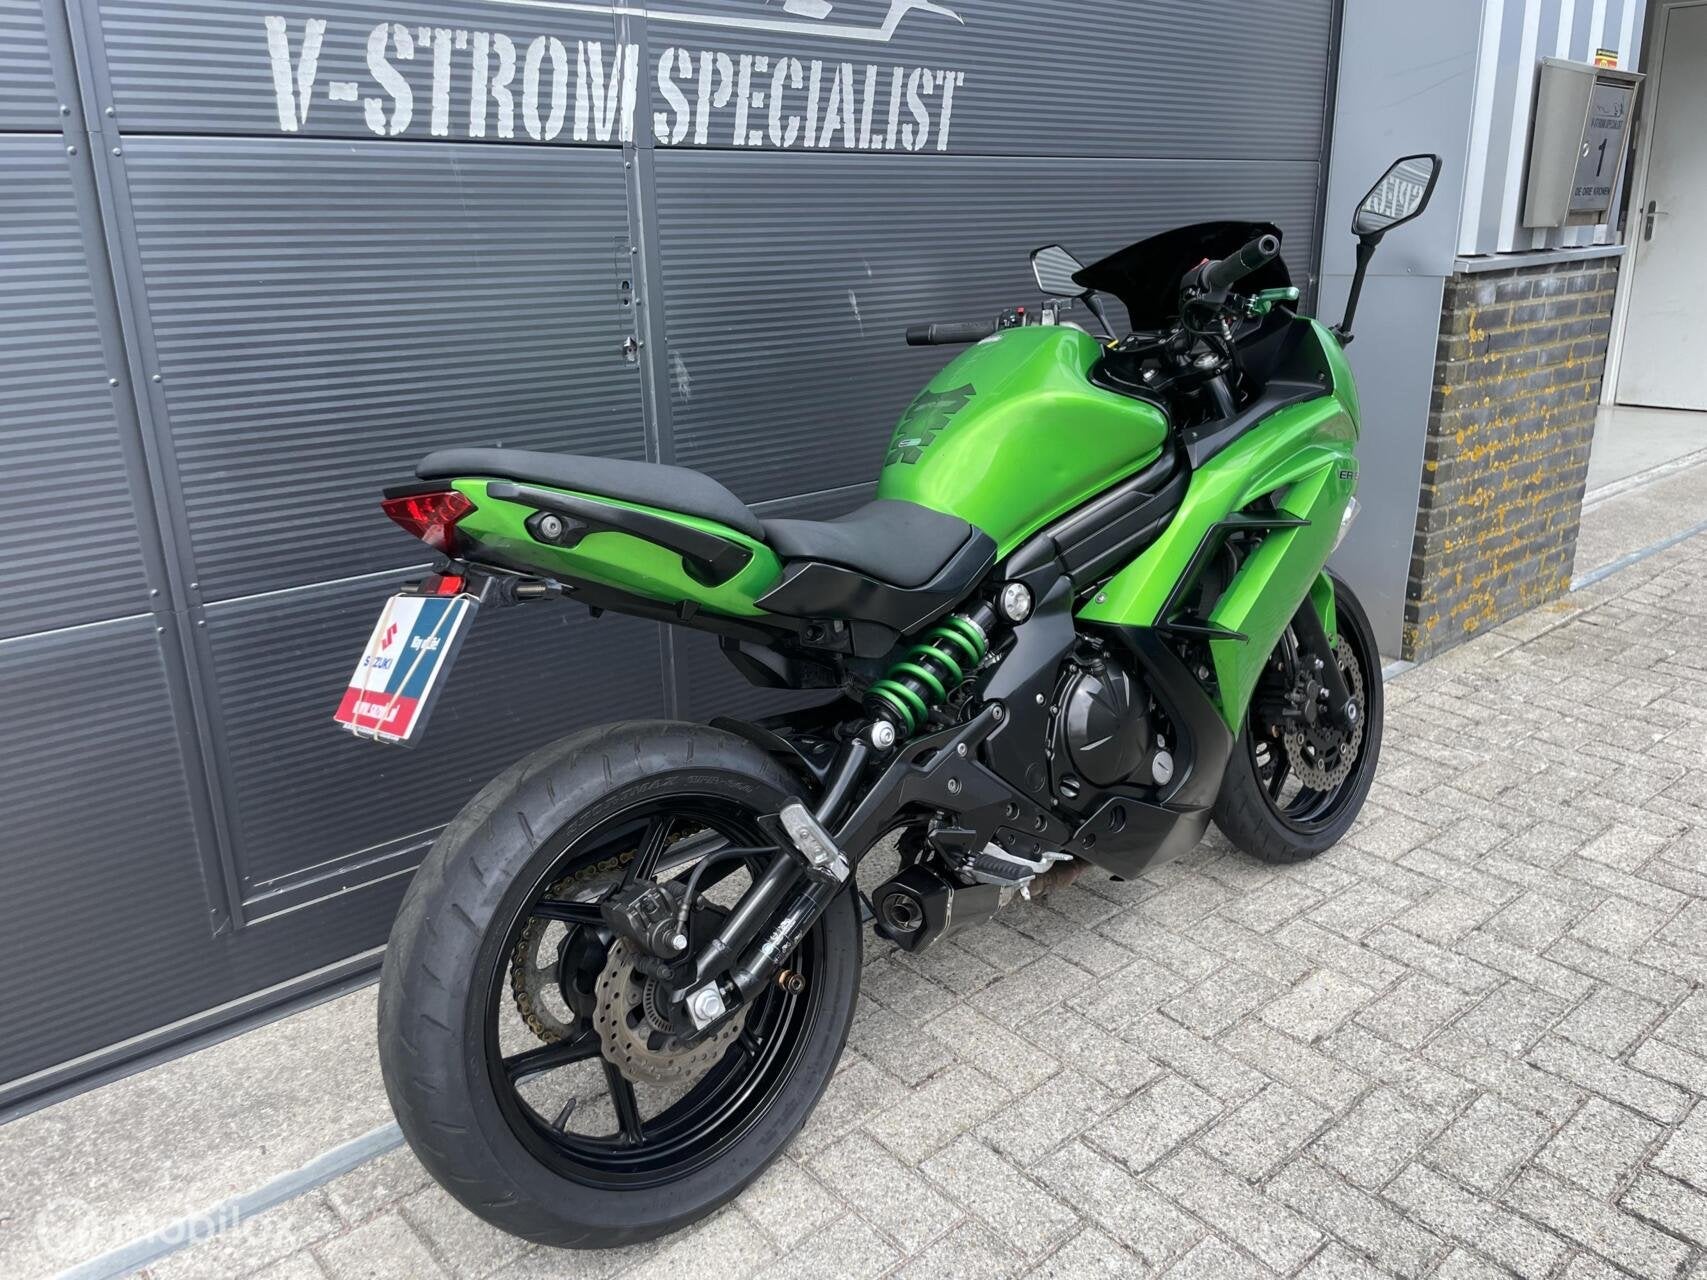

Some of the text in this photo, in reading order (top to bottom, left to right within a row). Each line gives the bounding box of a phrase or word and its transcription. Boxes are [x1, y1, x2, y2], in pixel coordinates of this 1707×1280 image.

[264, 15, 965, 152] V-STROM SPECIALIST
[1596, 138, 1607, 177] 1
[363, 656, 393, 670] SZUKI
